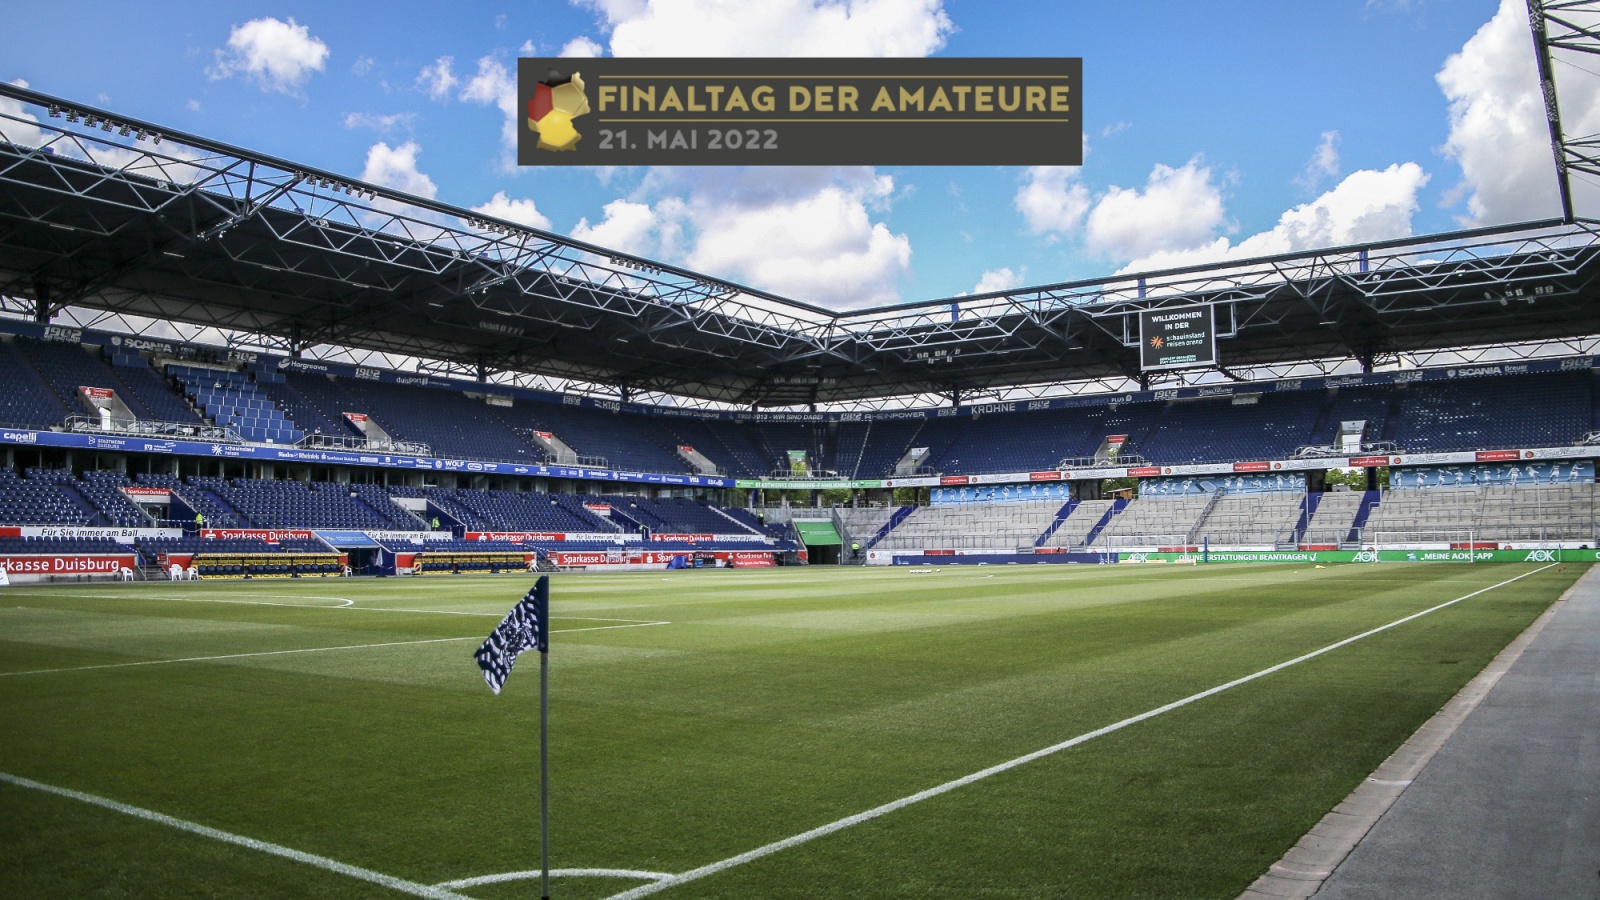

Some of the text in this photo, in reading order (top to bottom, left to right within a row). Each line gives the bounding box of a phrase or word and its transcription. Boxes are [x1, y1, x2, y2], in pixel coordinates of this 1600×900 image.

[1152, 311, 1202, 322] WILLKOMMEN
[1166, 332, 1205, 341] schauinsland
[124, 338, 172, 353] SCANIA
[291, 361, 328, 371] Hargreaves
[1458, 366, 1501, 376] SCANIA
[971, 403, 1015, 414] KROHNE
[865, 411, 925, 420] RHEINPOWER
[3, 432, 36, 442] capelli
[41, 528, 56, 536] Für
[60, 528, 74, 536] Sie
[76, 528, 104, 537] immer
[121, 528, 138, 536] Ball
[221, 530, 309, 540] Sparkasse Duisburg
[563, 555, 599, 565] Sparkasse
[1128, 552, 1148, 563] AOK
[1352, 551, 1378, 563] AOK
[1524, 550, 1556, 562] AOK
[54, 558, 119, 571] Duisburg
